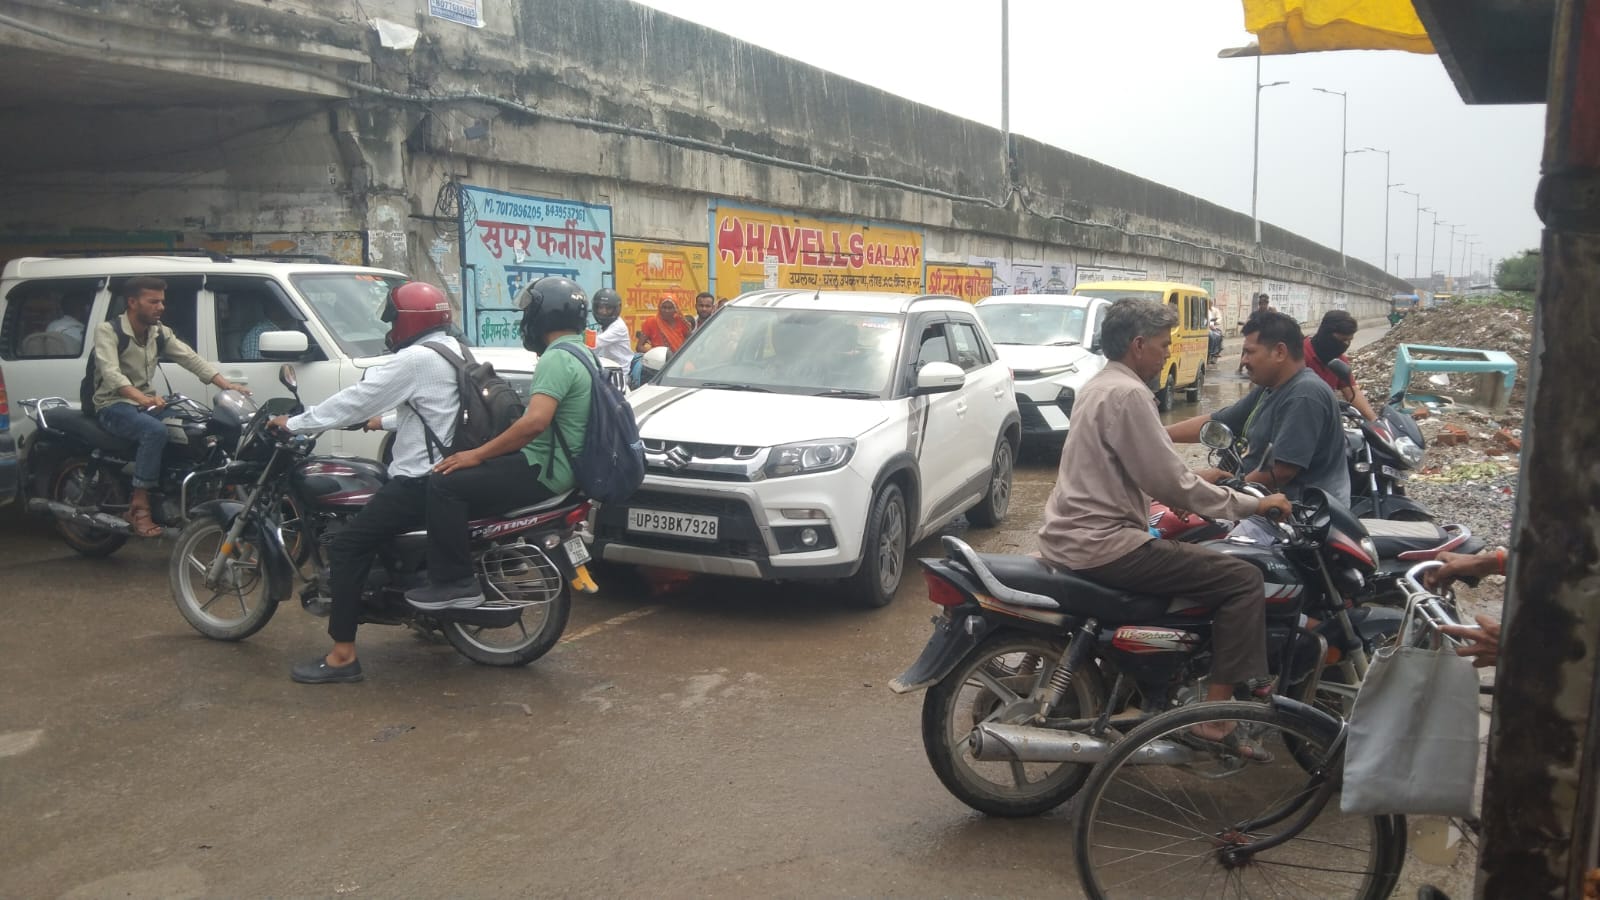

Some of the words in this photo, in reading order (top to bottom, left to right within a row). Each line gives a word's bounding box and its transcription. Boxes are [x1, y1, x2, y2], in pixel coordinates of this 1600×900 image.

[475, 219, 531, 259] सुपर
[535, 218, 606, 264] फर्नीचर
[745, 222, 865, 269] HAVELLS
[865, 243, 921, 269] GALAXY
[636, 512, 717, 535] UP93BK7928
